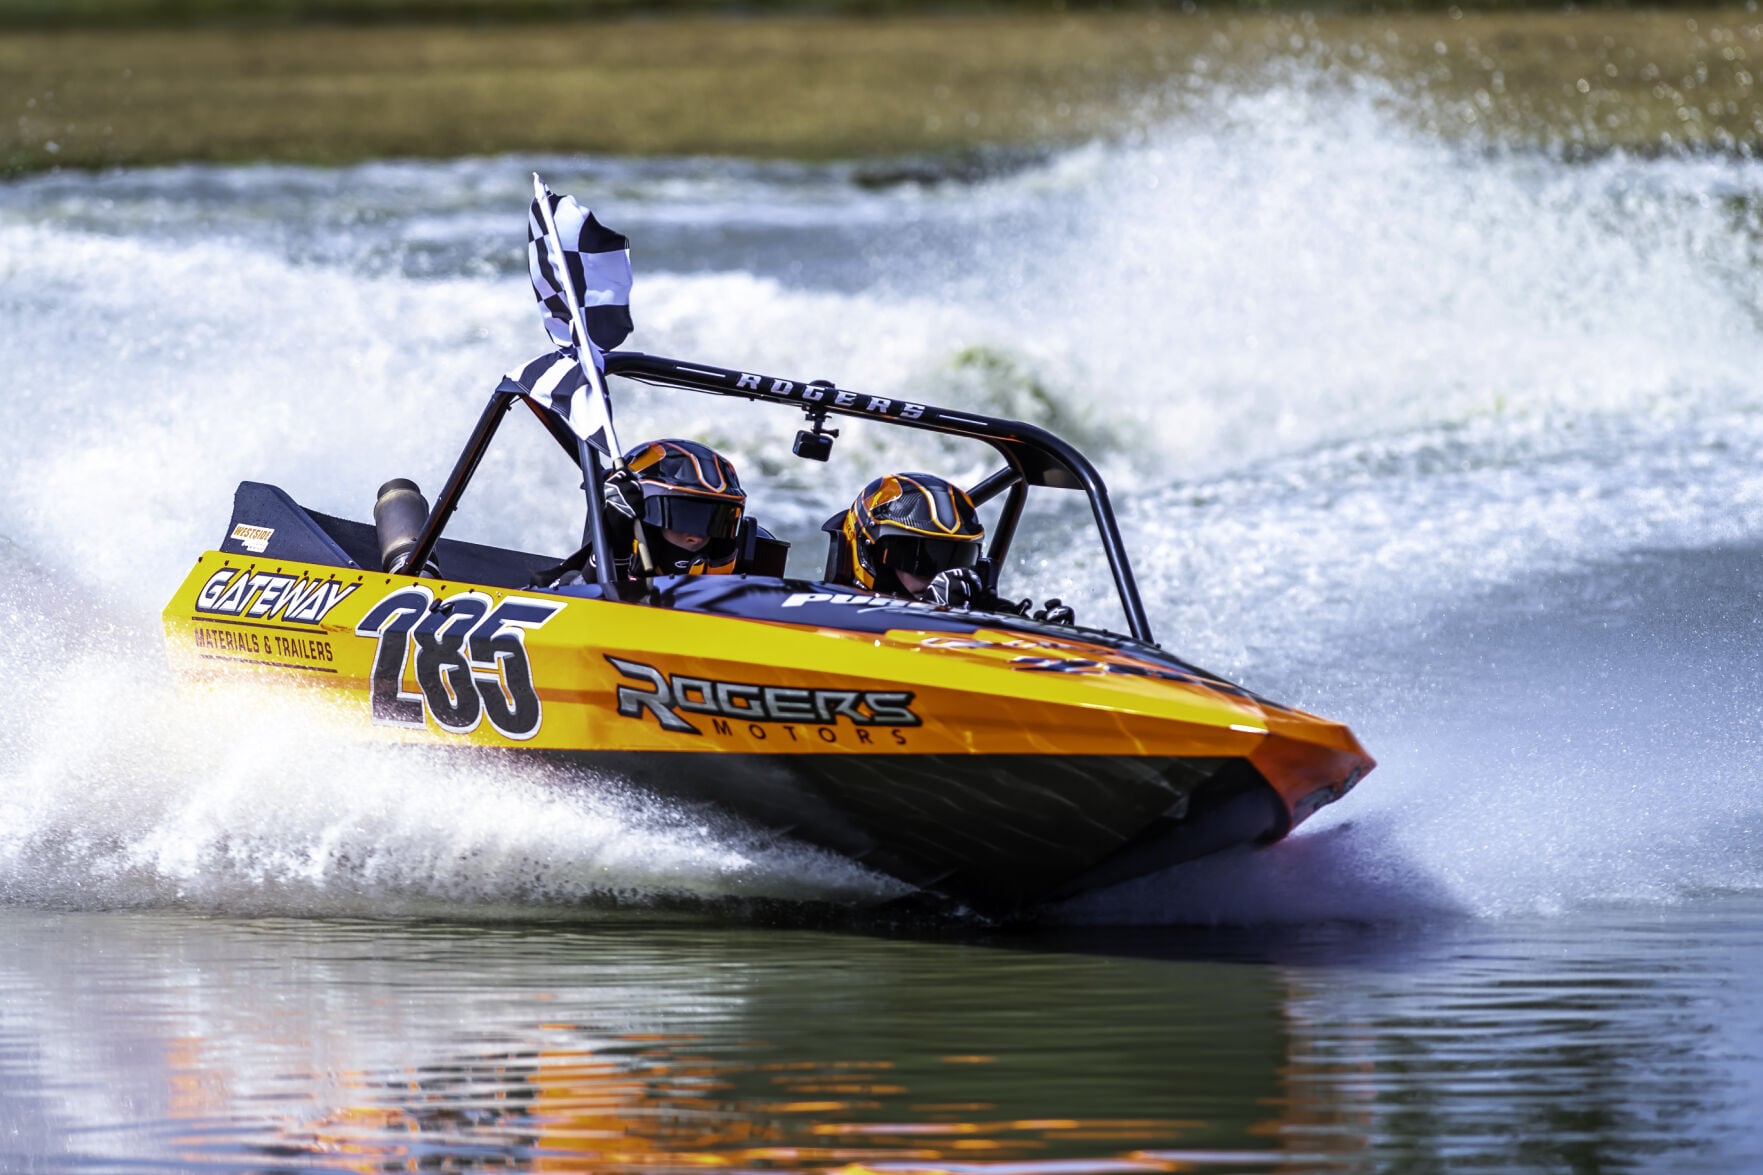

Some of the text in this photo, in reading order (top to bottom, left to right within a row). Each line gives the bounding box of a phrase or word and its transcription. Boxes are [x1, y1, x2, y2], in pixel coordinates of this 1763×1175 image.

[736, 373, 926, 419] ROGERS
[233, 526, 272, 541] WESTSIDE
[195, 567, 363, 625] GATEWAY
[194, 627, 334, 662] MATERIALS & TRAILERS
[355, 585, 568, 741] 285
[603, 653, 923, 736] ROGERS
[711, 718, 908, 745] MOTORS
